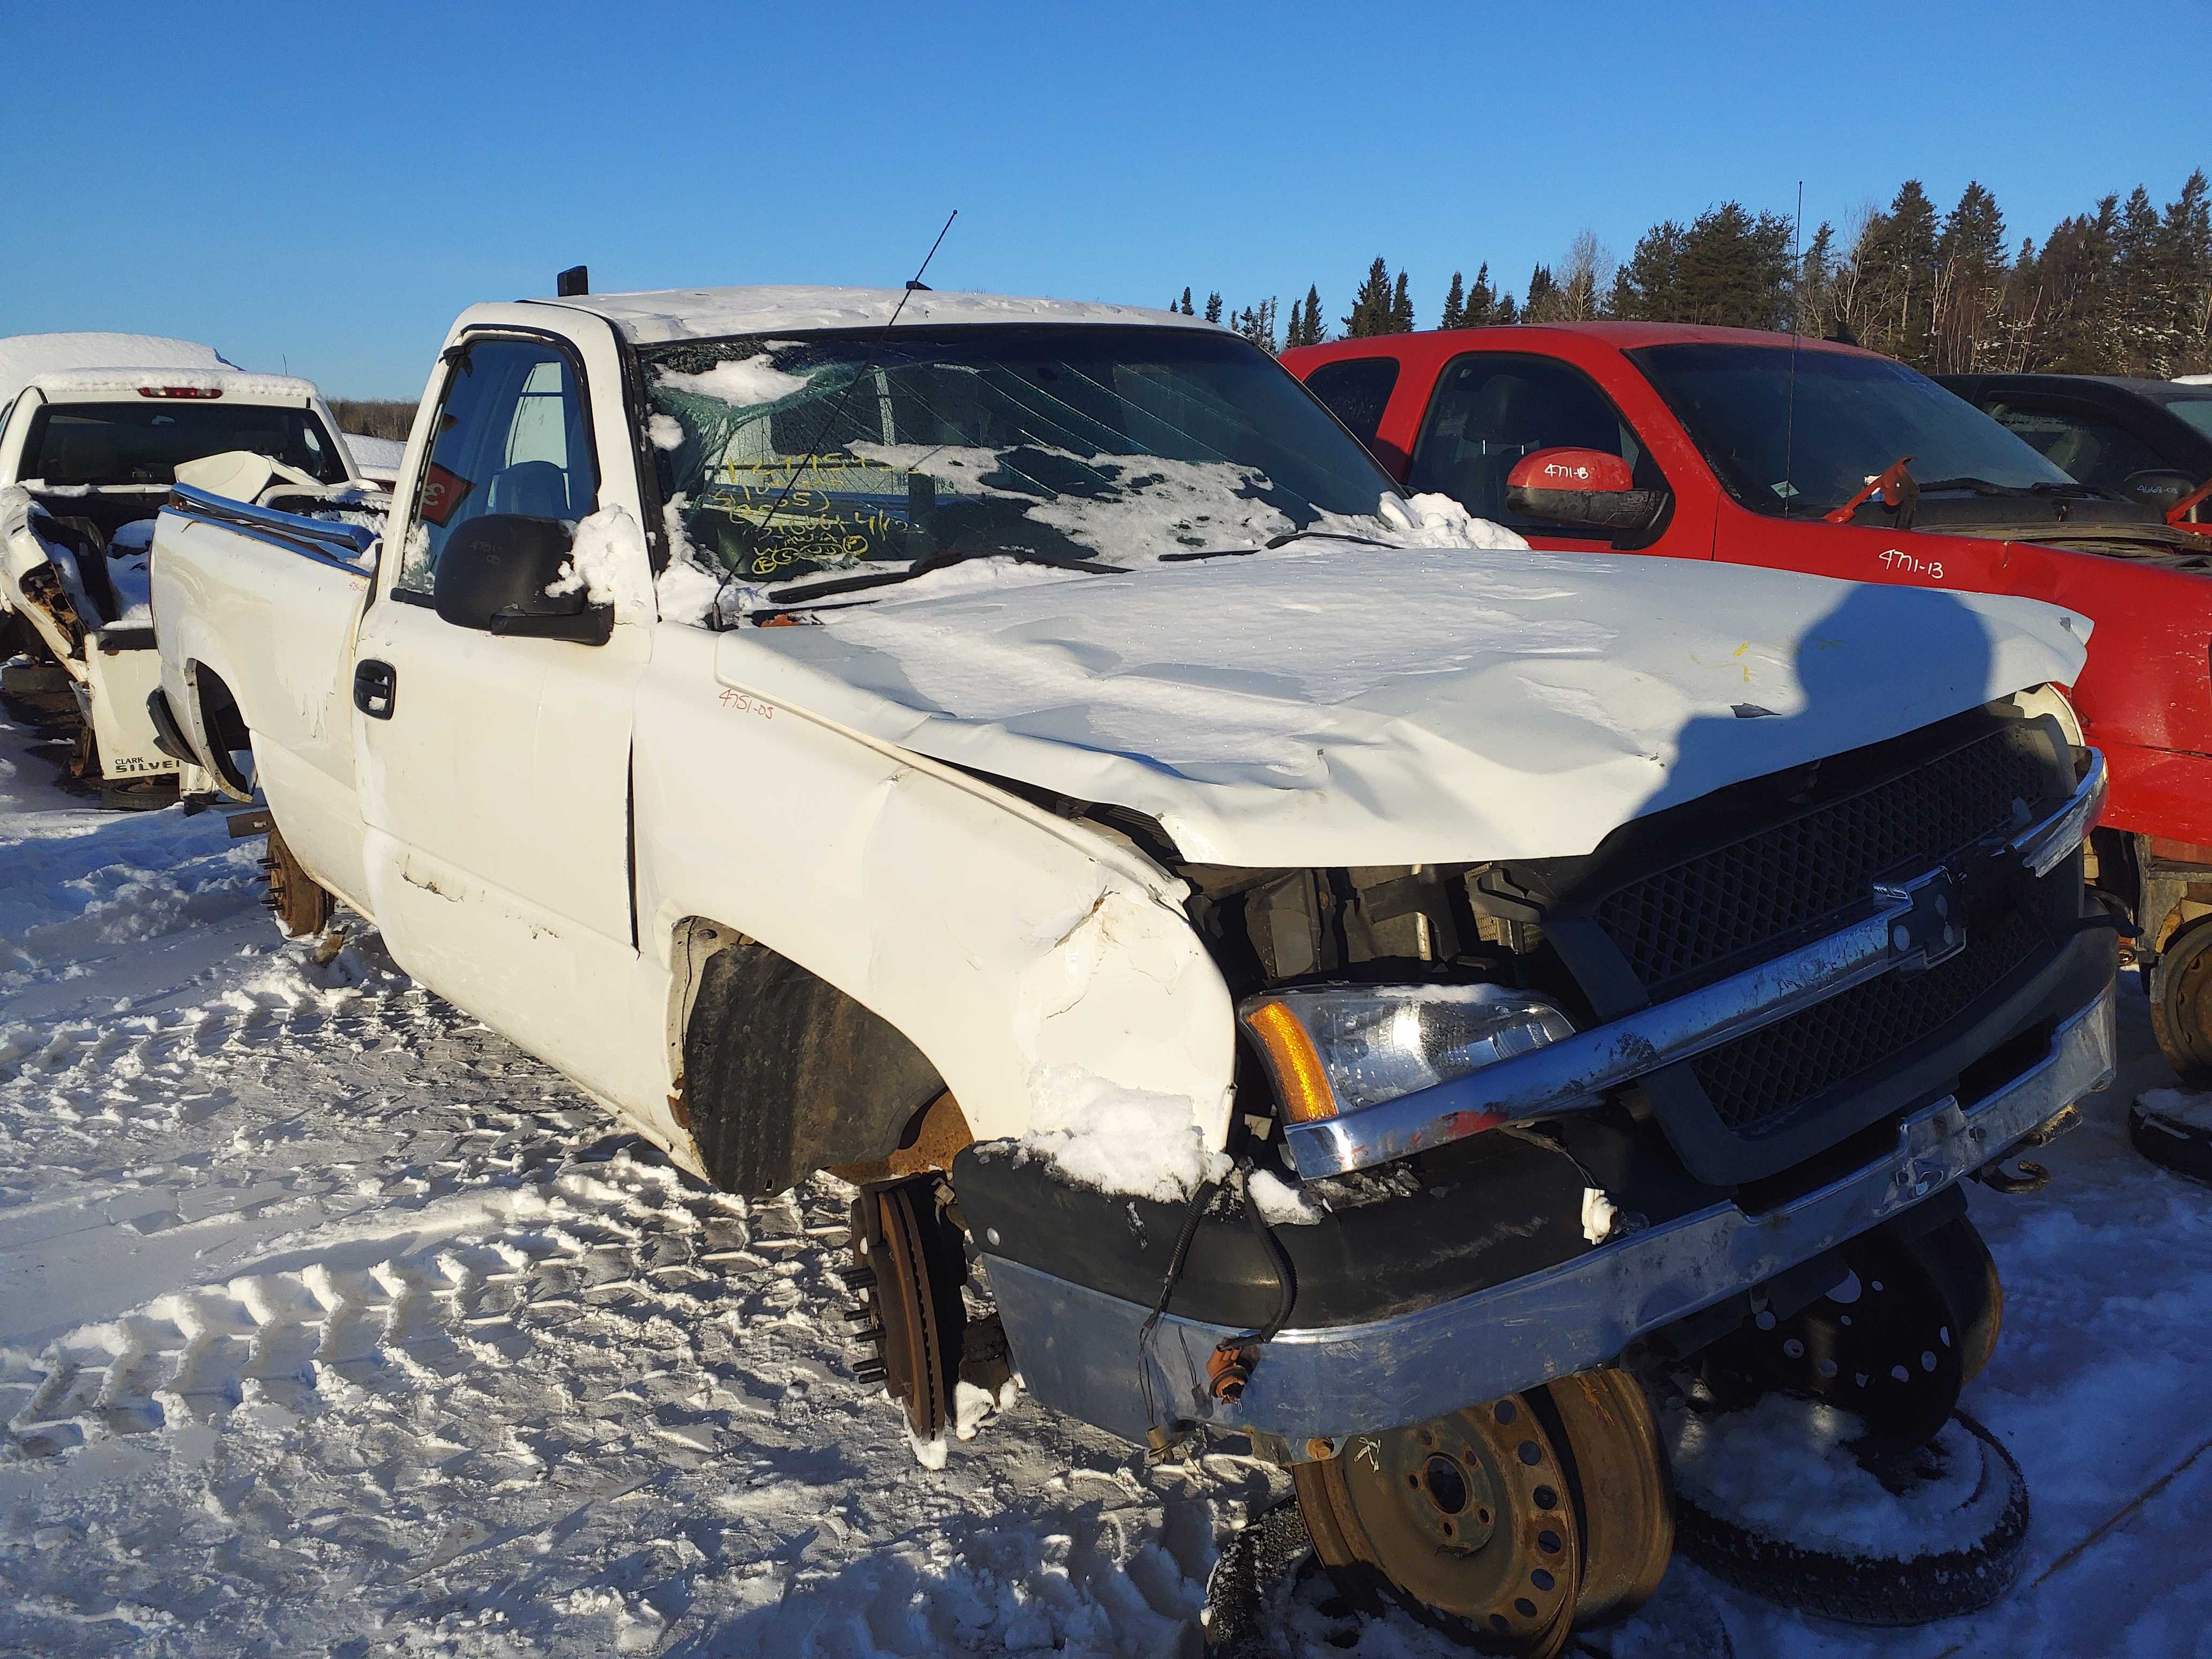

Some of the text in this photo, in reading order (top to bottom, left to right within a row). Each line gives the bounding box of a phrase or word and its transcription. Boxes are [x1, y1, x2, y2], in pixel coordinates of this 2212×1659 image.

[1878, 549, 1944, 579] 4771-13
[719, 689, 774, 719] 4751-05
[115, 757, 144, 765] CLARK
